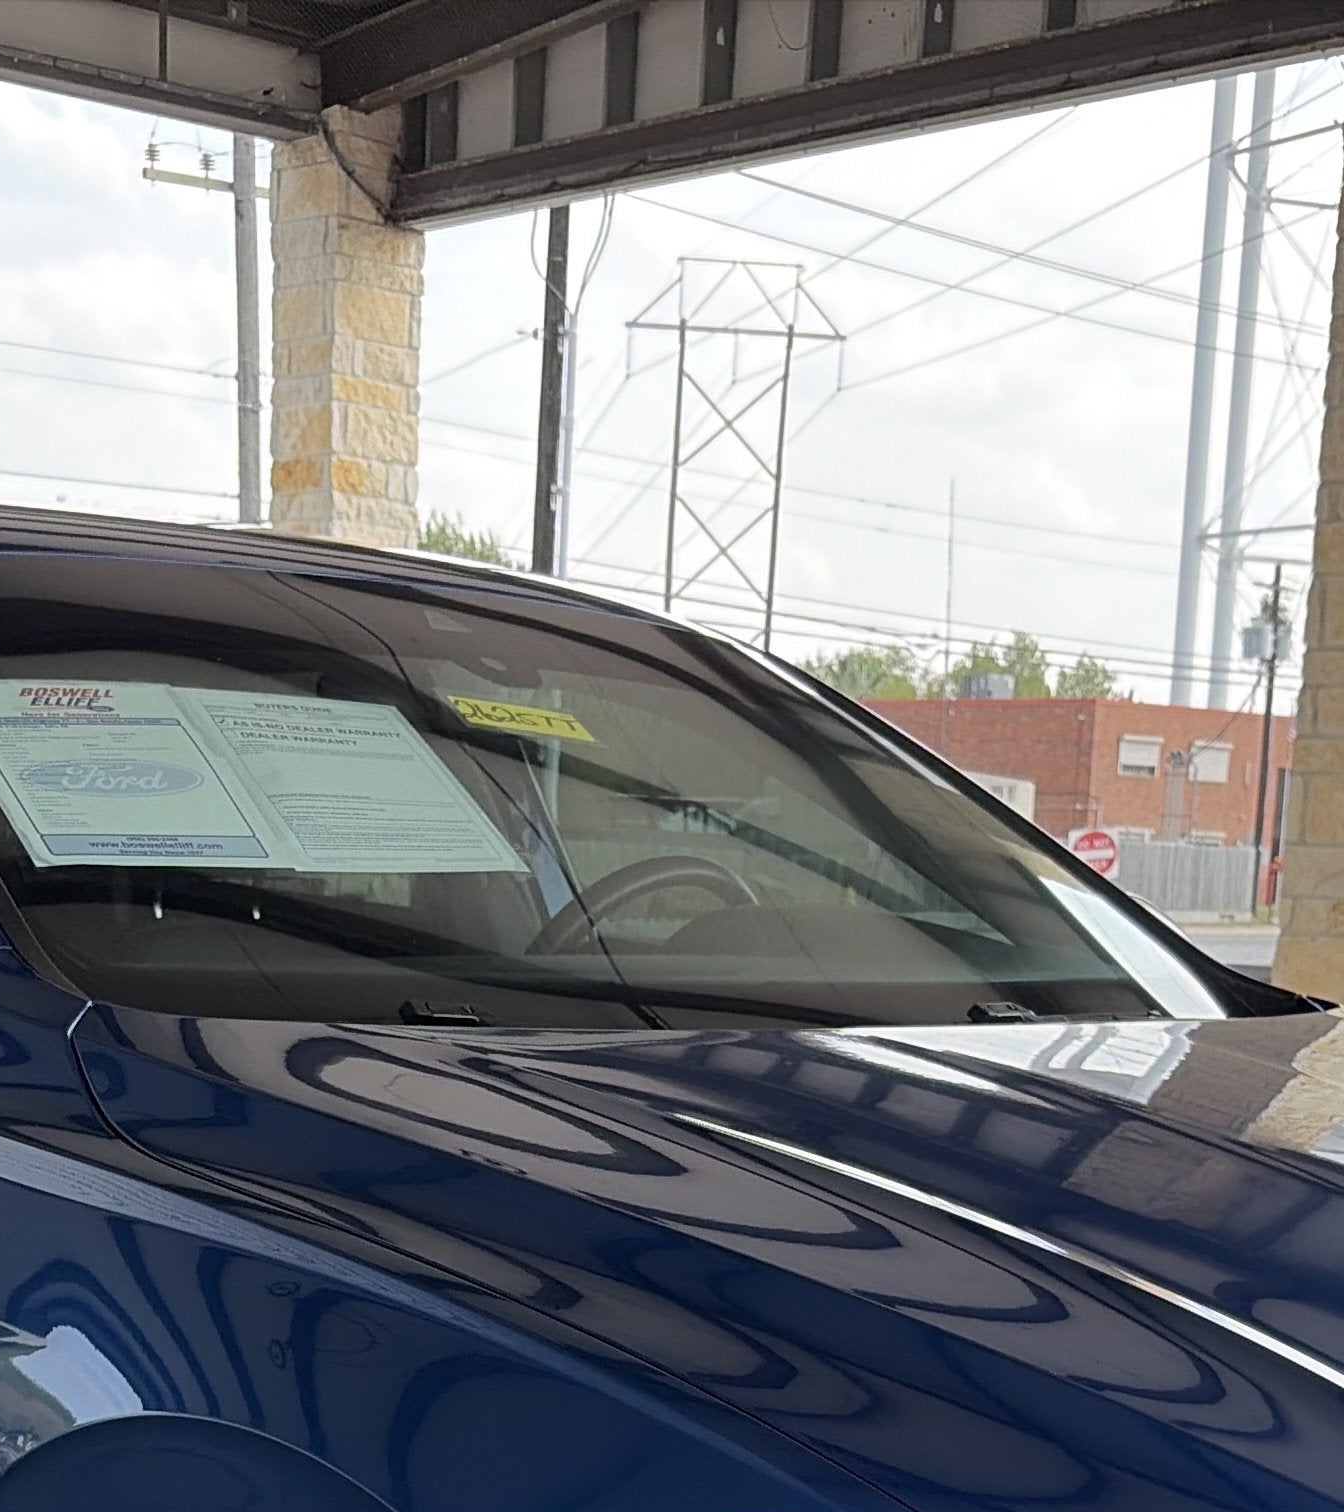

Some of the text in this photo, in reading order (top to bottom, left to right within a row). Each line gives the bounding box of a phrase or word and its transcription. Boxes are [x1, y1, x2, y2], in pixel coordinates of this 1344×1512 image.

[19, 687, 114, 698] BOSWELL
[30, 697, 101, 707] ELLIFF
[233, 720, 249, 728] AS
[286, 724, 336, 734] DEALER
[336, 728, 401, 738] WARRANTY
[240, 731, 358, 746] DEALER WARRANTY
[61, 764, 169, 791] Ford
